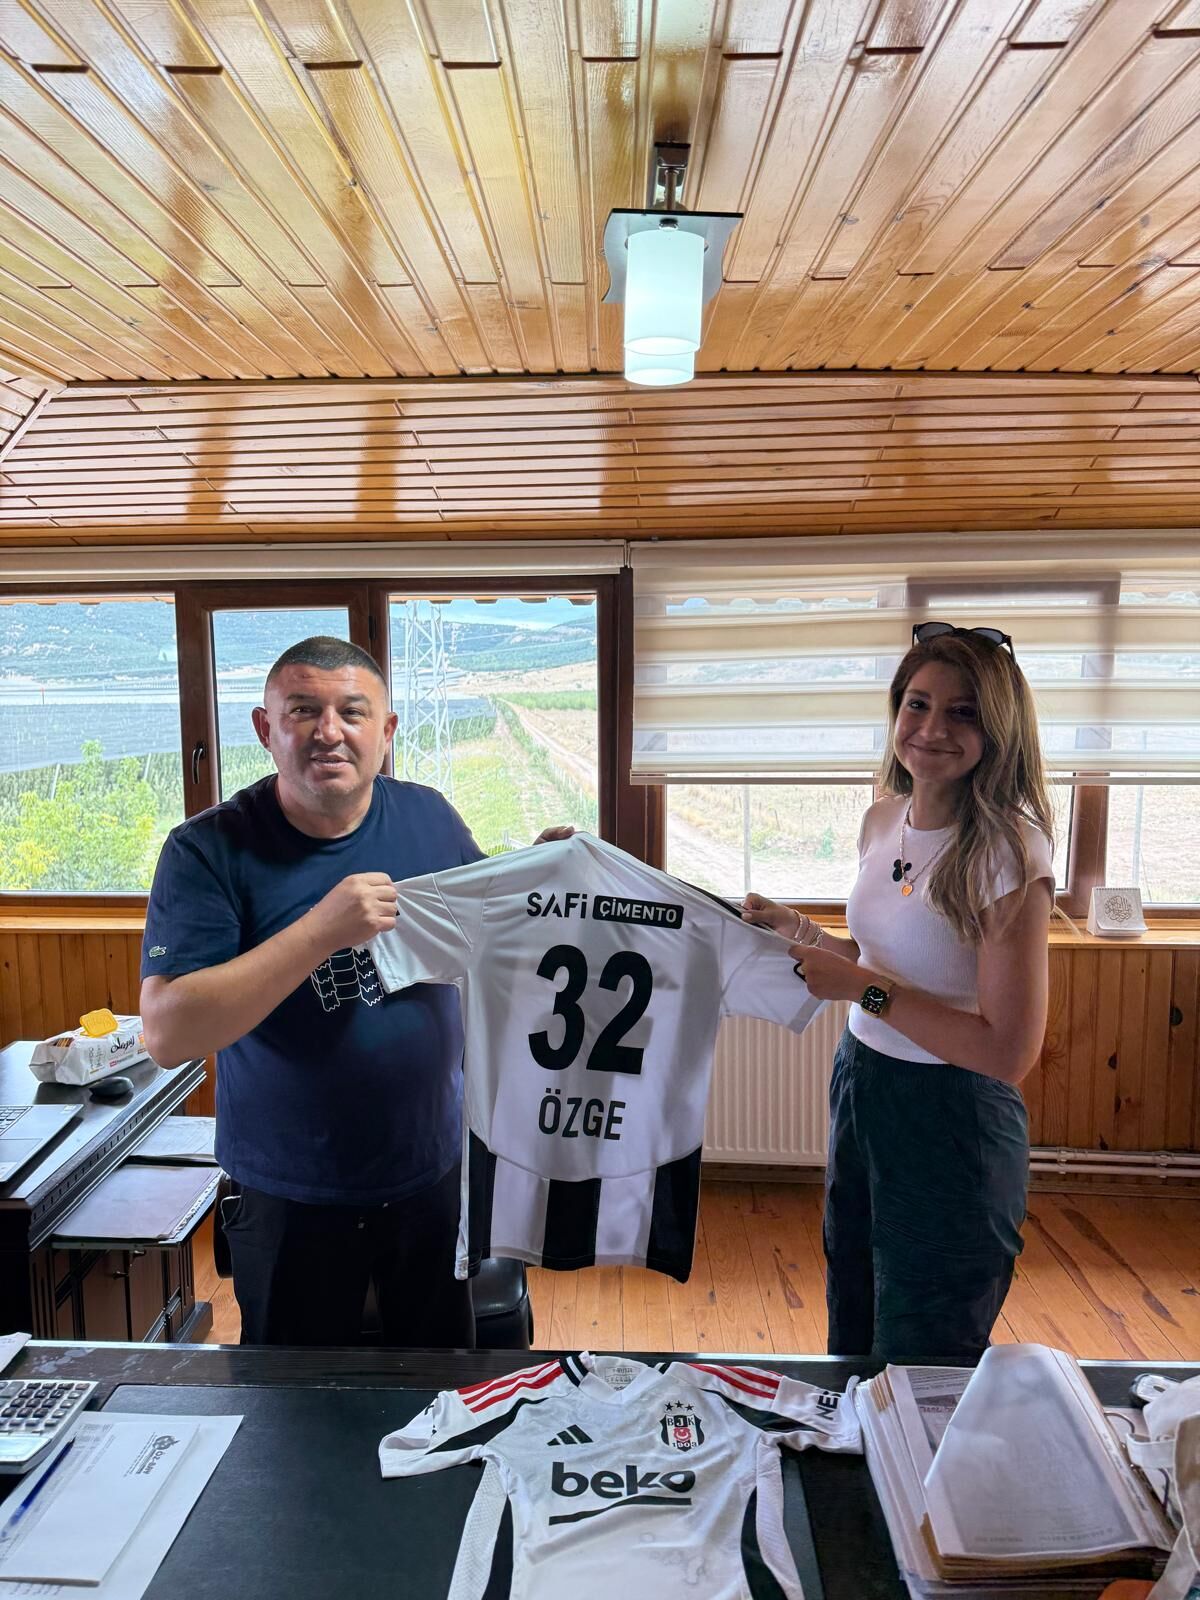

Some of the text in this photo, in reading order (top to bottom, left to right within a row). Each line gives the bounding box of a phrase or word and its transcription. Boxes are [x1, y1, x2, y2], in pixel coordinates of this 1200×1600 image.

[599, 898, 678, 924] ÇİMENTO
[528, 944, 653, 1075] 32
[538, 1087, 626, 1140] ÖZGE
[667, 1417, 695, 1427] BJK
[672, 1441, 698, 1449] 1903
[551, 1461, 696, 1499] beko
